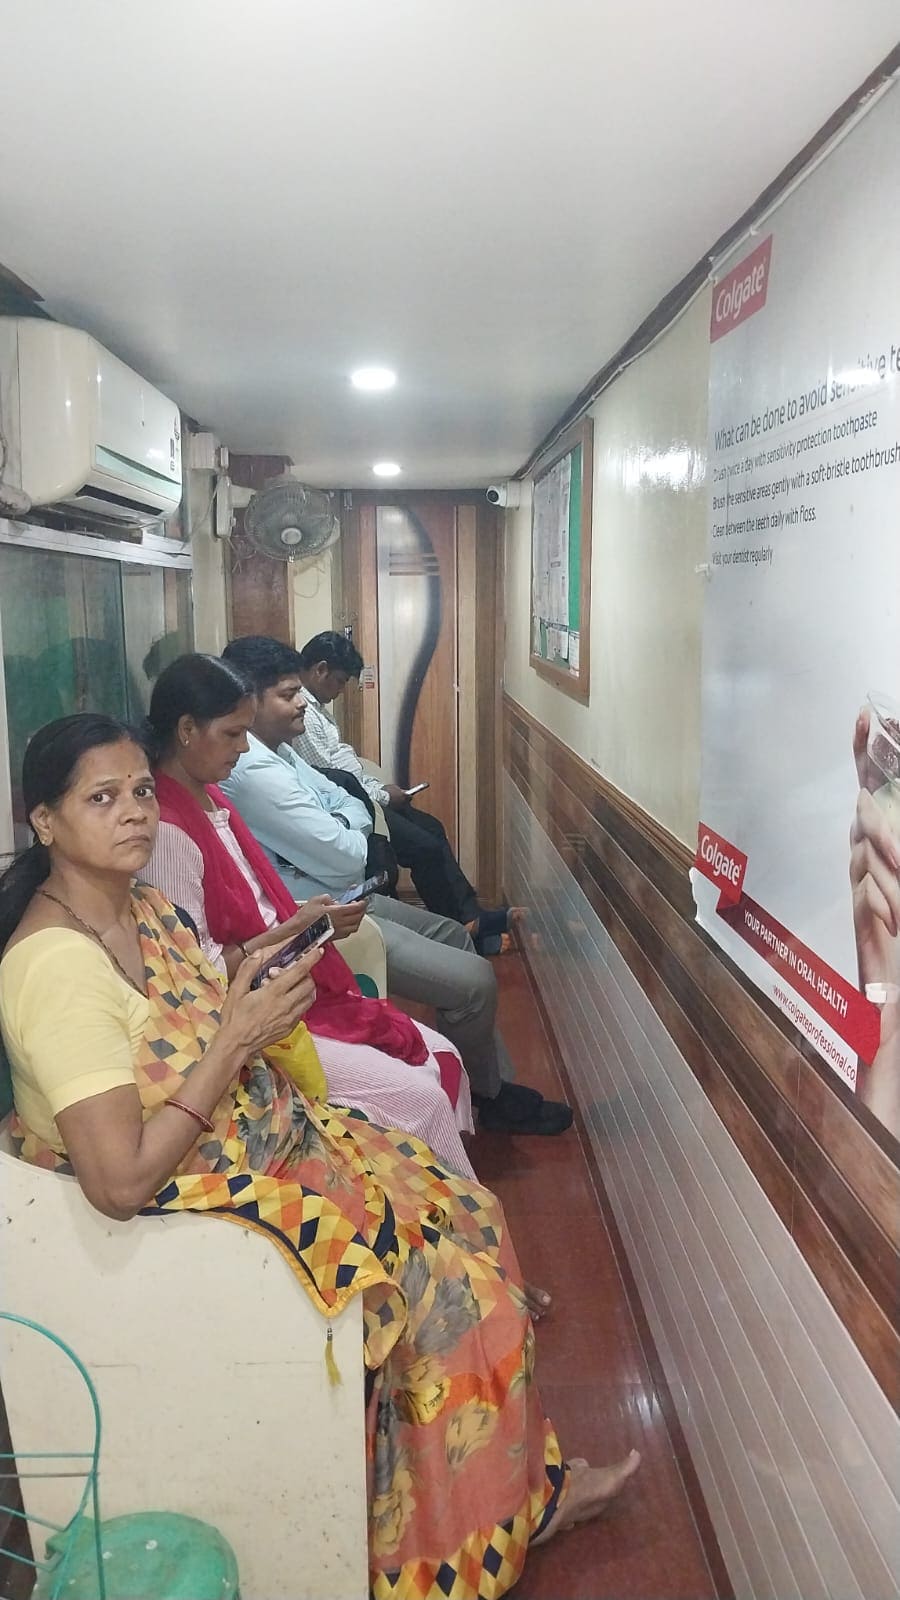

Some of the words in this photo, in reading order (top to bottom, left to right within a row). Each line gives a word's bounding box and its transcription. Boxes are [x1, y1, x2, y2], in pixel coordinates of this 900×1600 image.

[716, 264, 764, 321] Colgate
[715, 426, 734, 451] What
[736, 424, 749, 443] can
[751, 415, 760, 437] be
[763, 407, 785, 432] done
[788, 400, 797, 421] to
[799, 376, 828, 416] avoid
[745, 457, 753, 475] day
[755, 450, 766, 466] with
[767, 441, 796, 464] sensitivity
[797, 429, 832, 458] protection
[834, 410, 877, 438] toothpaste
[713, 496, 726, 510] Brush
[735, 486, 756, 503] sensitive
[757, 483, 771, 500] areas
[772, 477, 789, 500] gently
[791, 471, 804, 488] with
[806, 472, 810, 486] a
[811, 457, 850, 485] soft-bristle
[852, 441, 900, 474] toothbrush
[712, 524, 725, 537] Clean
[725, 521, 746, 536] between
[746, 517, 755, 532] the
[756, 514, 770, 530] teeth
[771, 510, 785, 530] daily
[785, 507, 799, 525] with
[723, 553, 732, 567] your
[733, 547, 749, 563] dentist
[749, 544, 773, 567] regularly
[701, 835, 740, 886] Colgate
[744, 910, 760, 935] YOUR
[760, 924, 789, 962] PARTNER
[789, 949, 797, 969] IN
[797, 958, 816, 989] ORAL
[817, 976, 848, 1018] HEALTH
